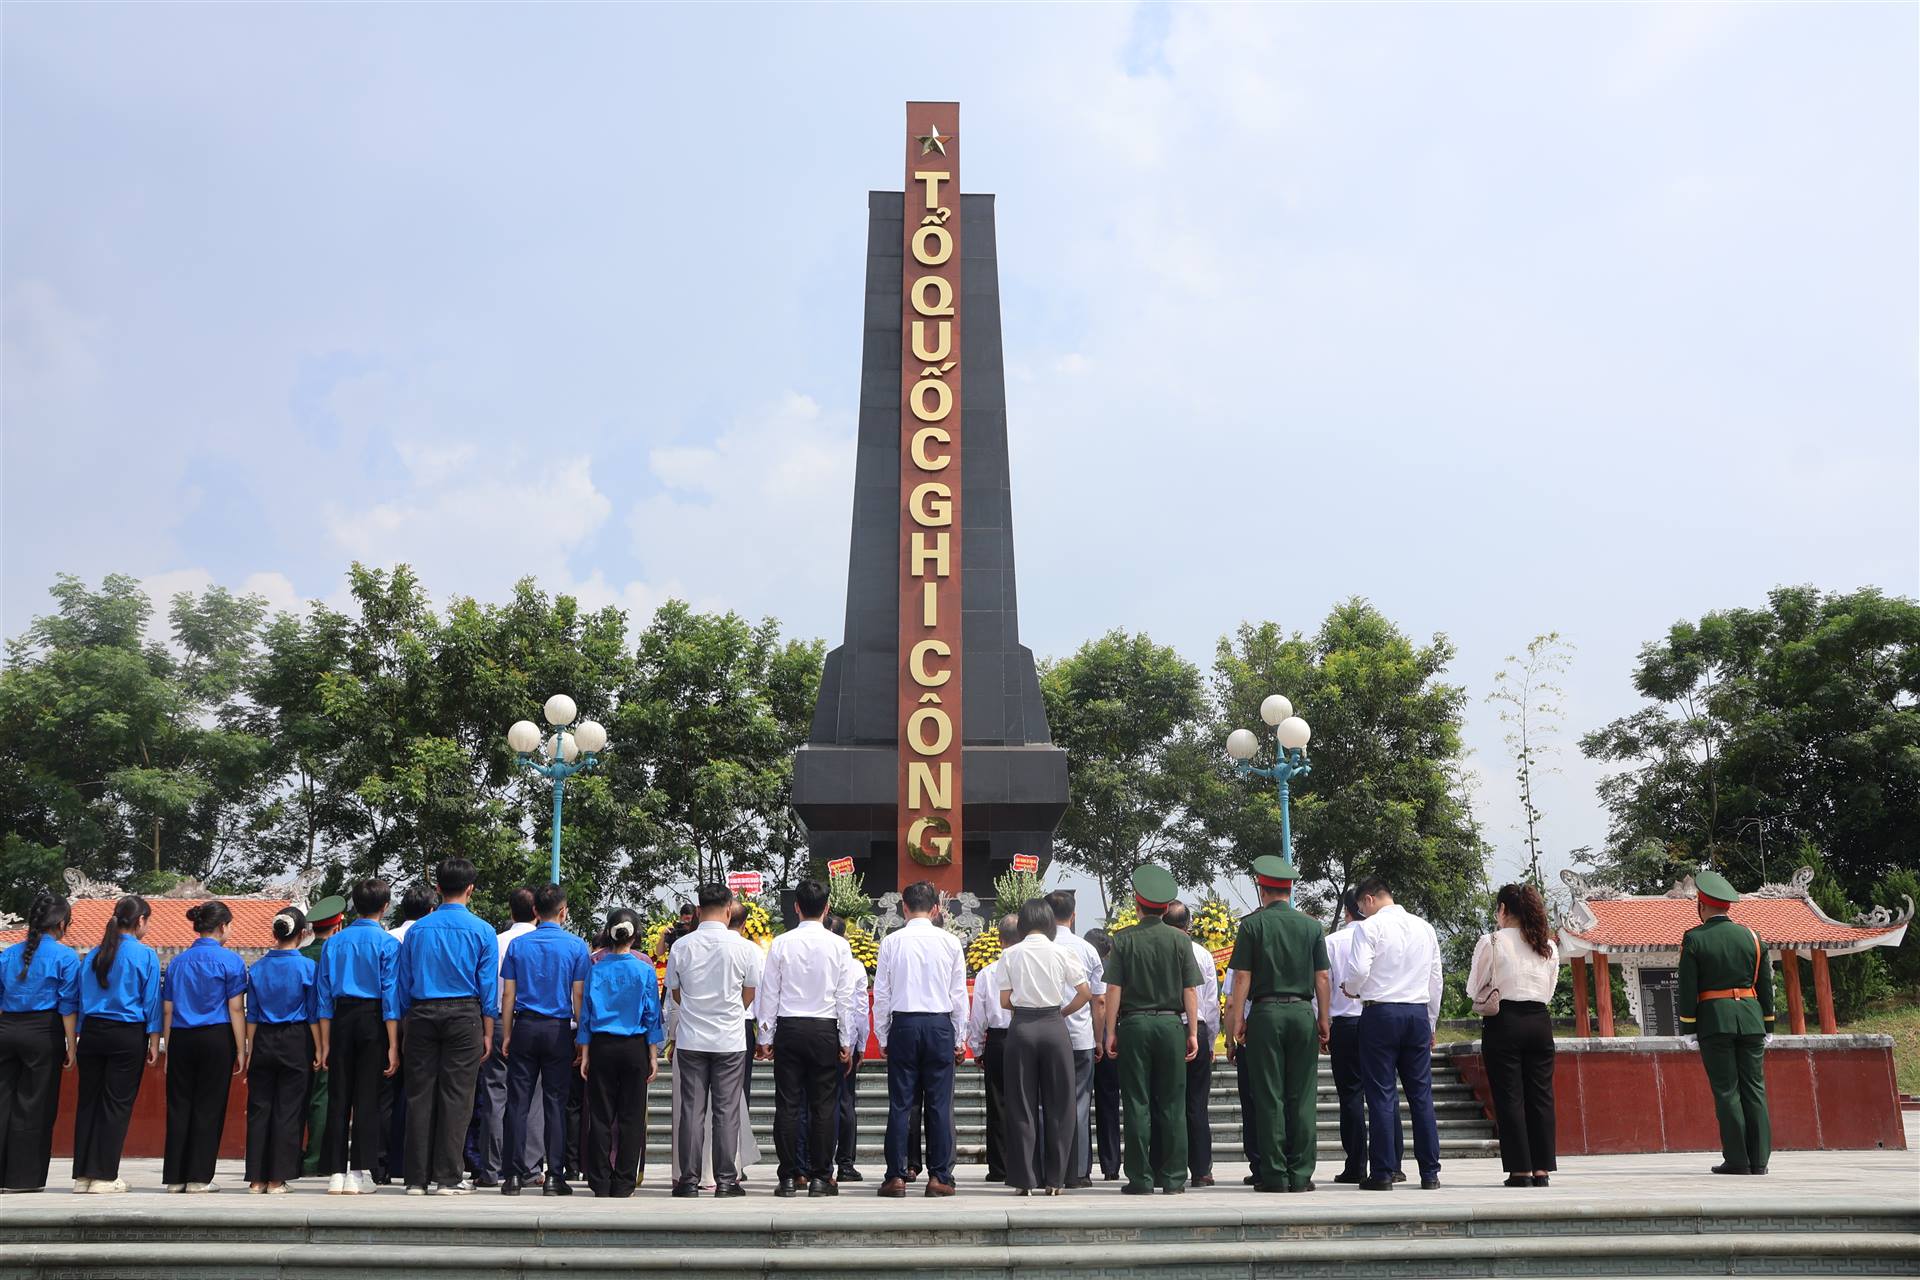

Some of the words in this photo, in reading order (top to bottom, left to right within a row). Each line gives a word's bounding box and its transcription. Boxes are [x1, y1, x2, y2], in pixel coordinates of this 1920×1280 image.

[911, 171, 954, 266] TỔ
[909, 275, 958, 472] QUỐC
[908, 482, 953, 628] GHI
[906, 639, 954, 867] CÔNG
